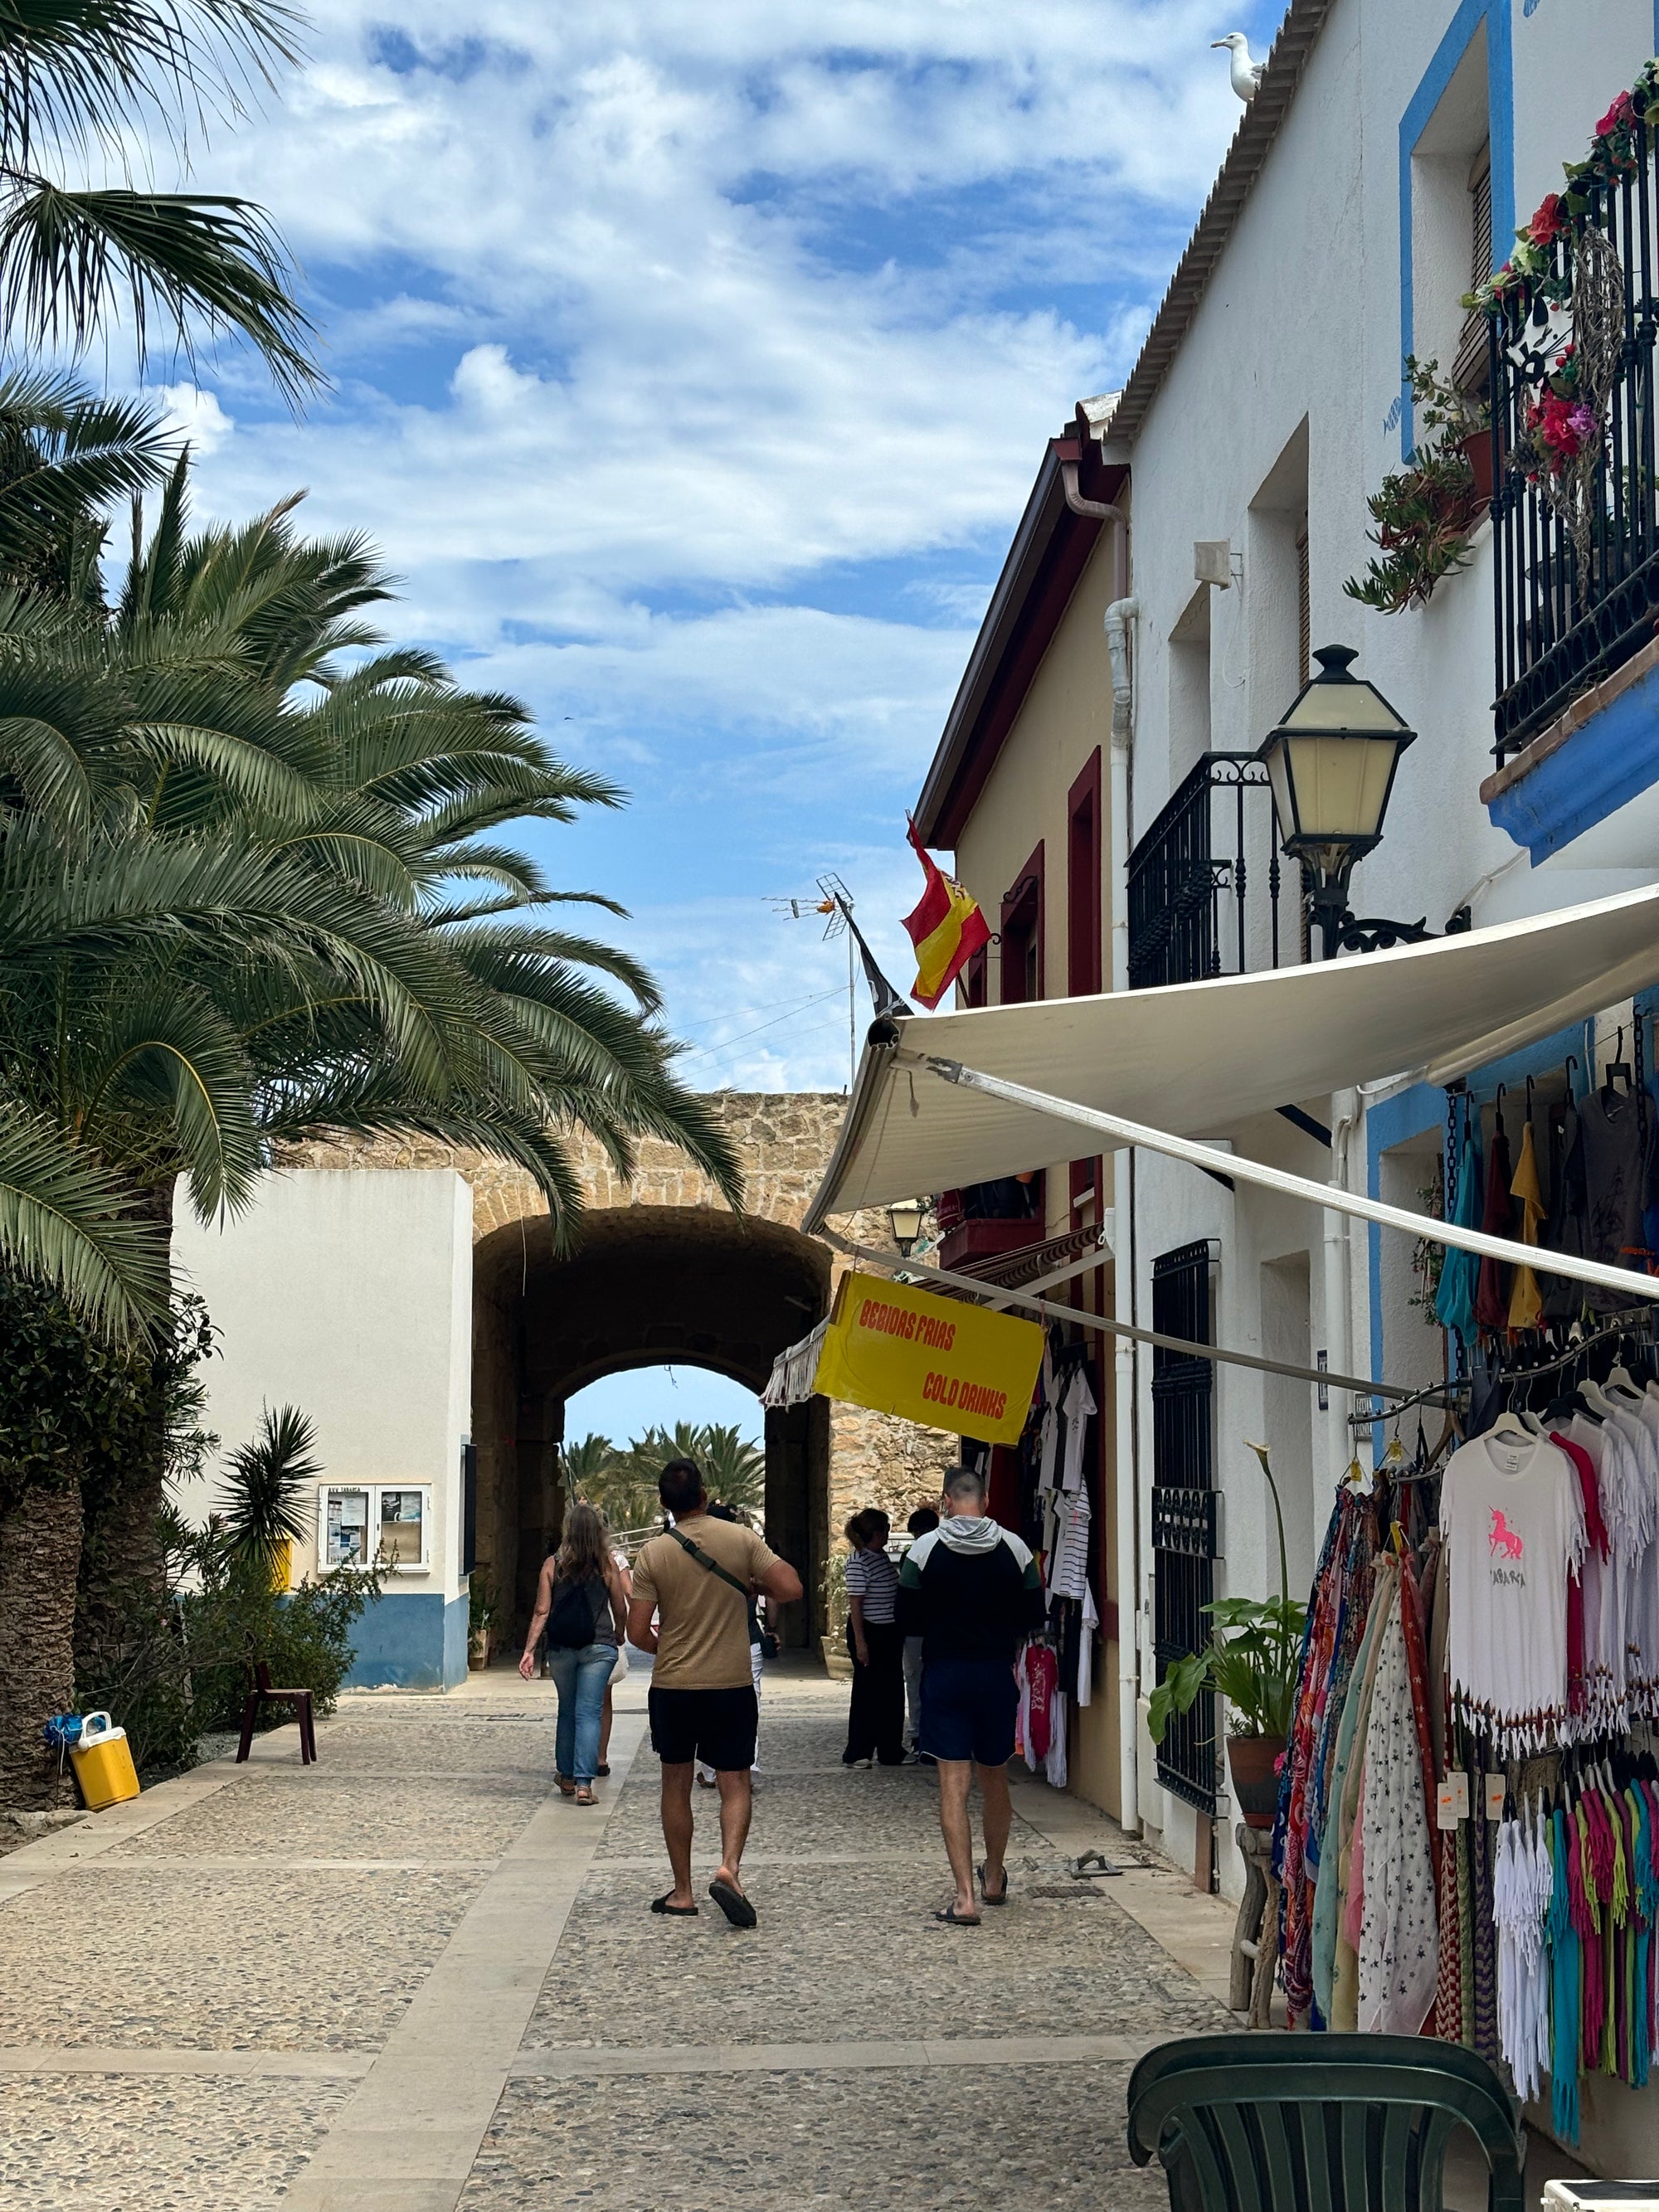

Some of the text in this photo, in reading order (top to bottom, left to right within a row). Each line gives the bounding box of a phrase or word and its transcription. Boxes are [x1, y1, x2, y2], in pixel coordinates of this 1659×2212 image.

[859, 1299, 916, 1339] BEBIDAS
[922, 1372, 1007, 1420] COLD DRINKS
